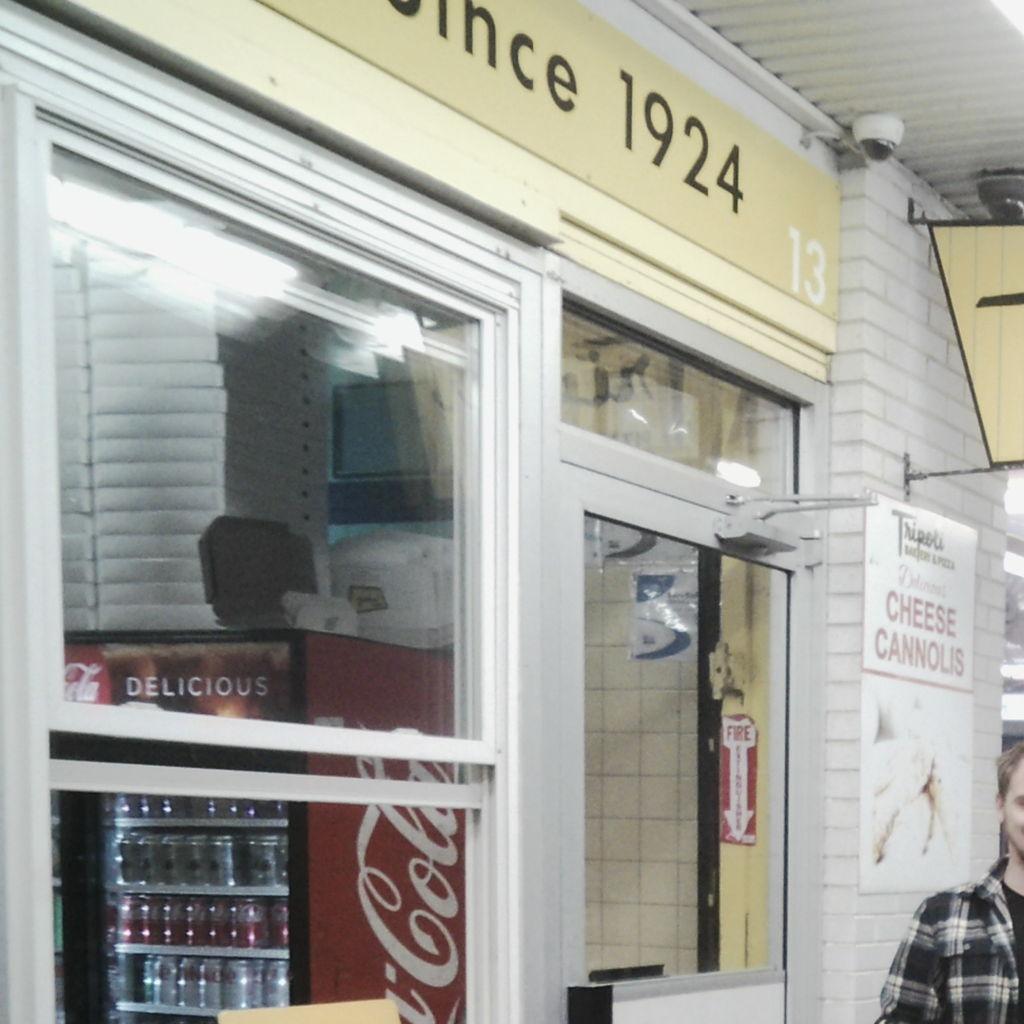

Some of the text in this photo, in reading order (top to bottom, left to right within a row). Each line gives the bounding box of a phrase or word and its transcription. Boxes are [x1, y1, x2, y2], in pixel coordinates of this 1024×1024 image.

[388, 0, 744, 214] ince 1924
[788, 225, 826, 305] 13
[886, 590, 957, 638] CHEESE
[875, 628, 965, 677] CANNOLIS
[126, 676, 269, 697] DELICIOUS
[727, 725, 751, 741] FIRE
